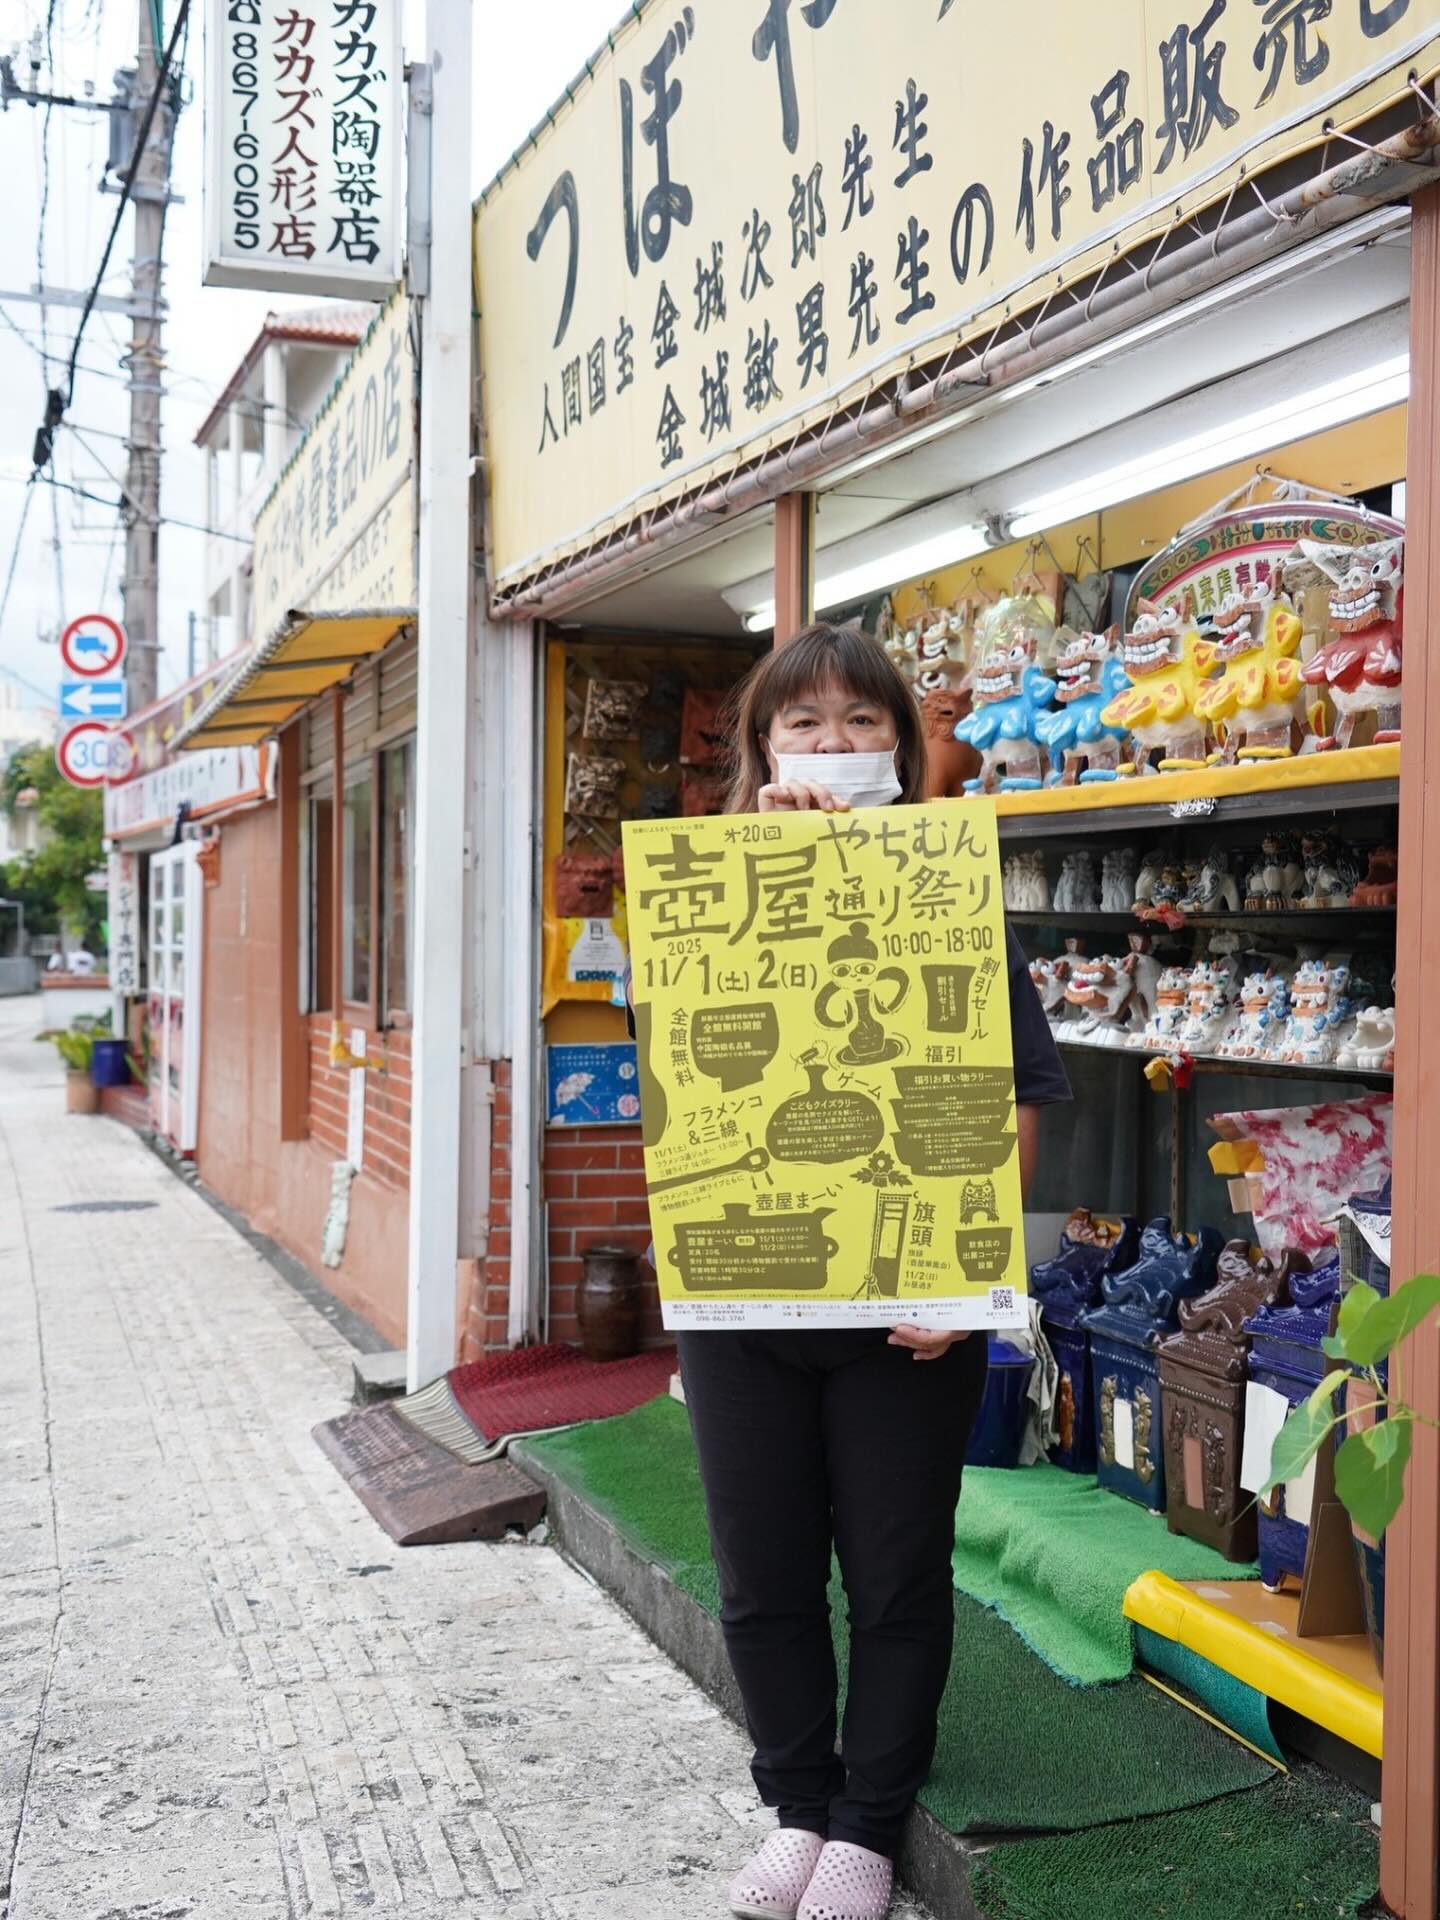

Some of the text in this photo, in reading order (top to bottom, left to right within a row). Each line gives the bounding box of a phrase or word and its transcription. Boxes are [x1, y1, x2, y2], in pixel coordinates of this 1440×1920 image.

[232, 32, 259, 249] 867-6055
[267, 8, 323, 261] カカズ人形店
[326, 0, 387, 264] カカズ陶器店
[538, 315, 634, 454] 人間国宝
[817, 816, 988, 873] やちむん
[640, 833, 824, 946] 壺屋
[824, 864, 991, 927] 通り祭り
[667, 938, 702, 957] 2025
[970, 956, 1001, 1041] 割引セール
[669, 1007, 696, 1088] 全館無料
[925, 1044, 962, 1064] 福引
[683, 1095, 763, 1127] フラメンコ
[789, 1098, 860, 1111] こどもクイズラリー
[837, 1071, 882, 1101] ゲーム
[688, 1120, 740, 1146] &三線
[755, 1183, 843, 1212] 壺屋まーい
[909, 1200, 937, 1248] 旗頭
